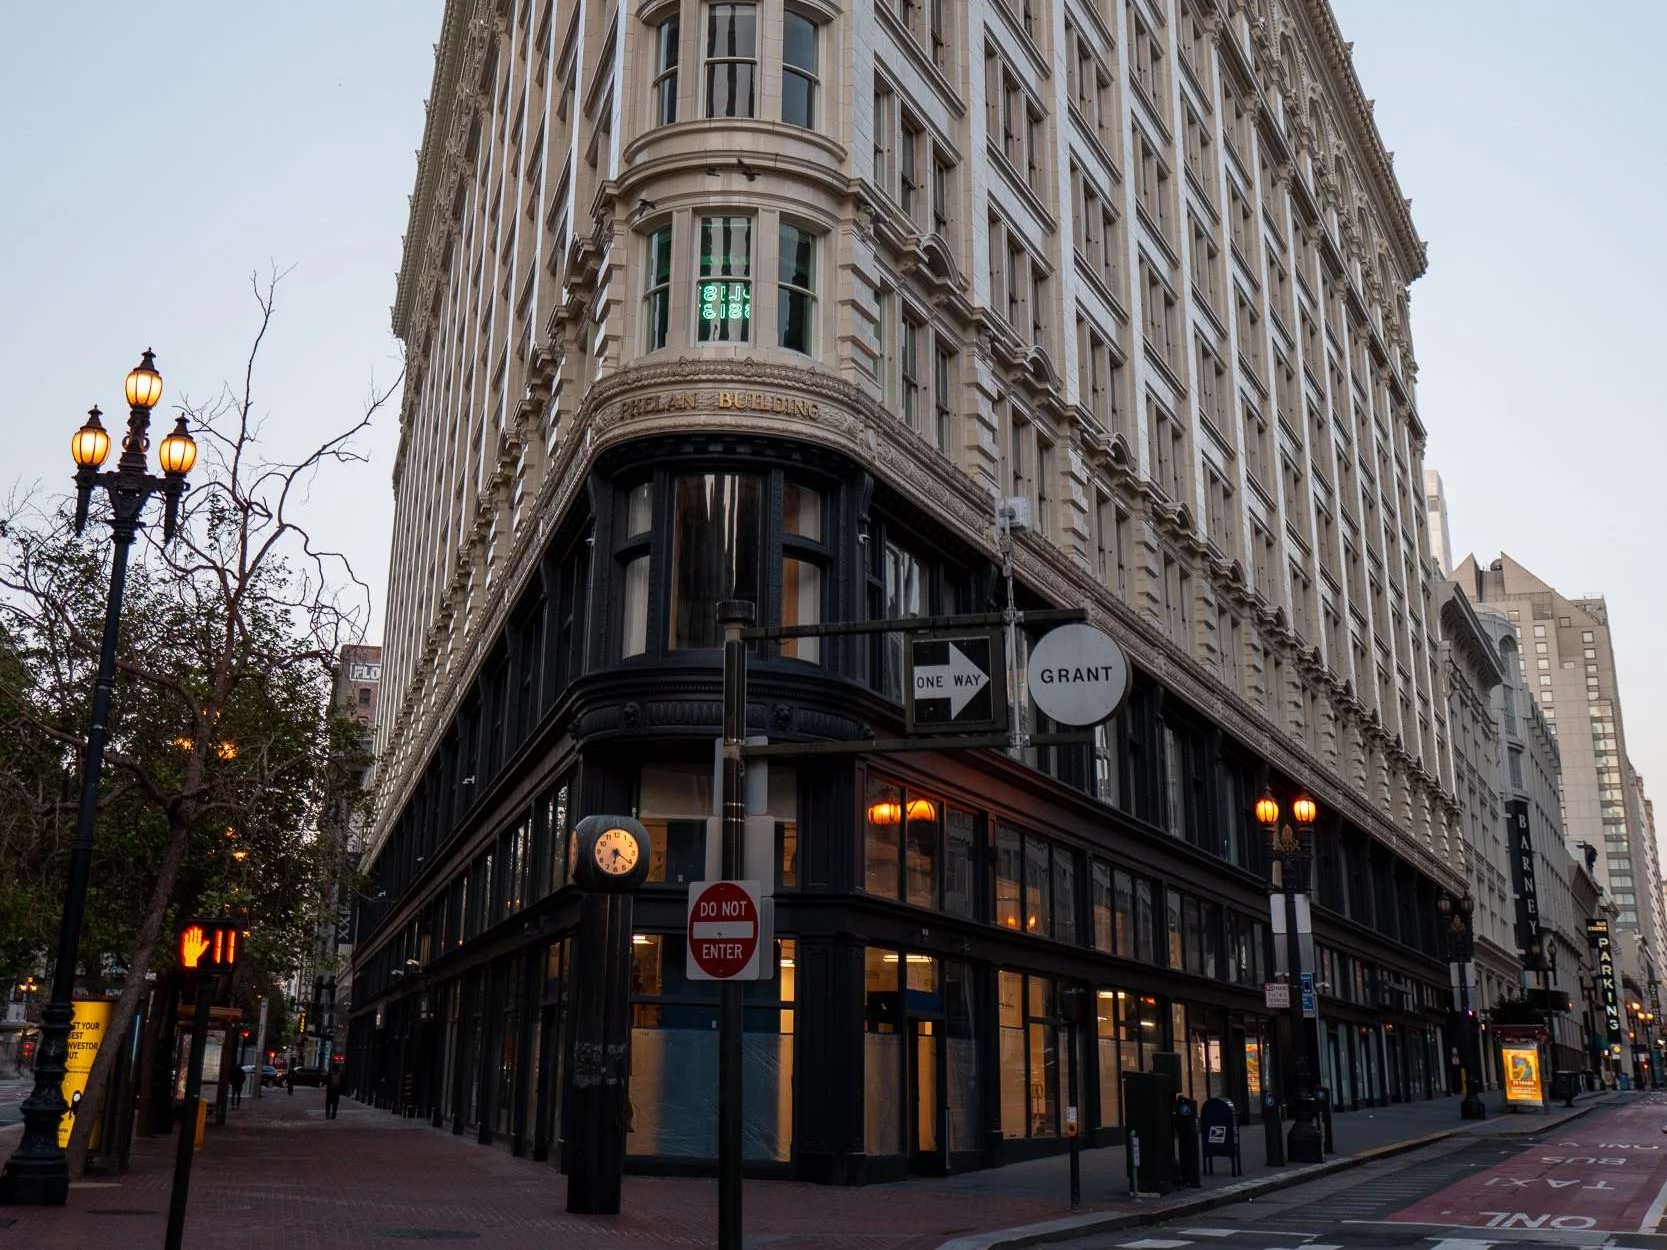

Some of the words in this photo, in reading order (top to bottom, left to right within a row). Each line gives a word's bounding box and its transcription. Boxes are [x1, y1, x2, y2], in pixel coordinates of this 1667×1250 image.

[619, 391, 697, 419] PHELAN
[718, 391, 820, 419] BUILDING
[916, 676, 944, 689] ONE
[954, 674, 981, 687] WAY
[1040, 666, 1113, 684] GRANT
[700, 901, 717, 917] DO
[721, 901, 748, 916] NOT
[702, 943, 743, 959] ENTER
[1598, 937, 1620, 1030] PARKING
[82, 1021, 100, 1030] YOUR
[68, 1041, 98, 1051] NVESTOR
[69, 1051, 79, 1060] UT.
[1441, 1210, 1597, 1230] ONL
